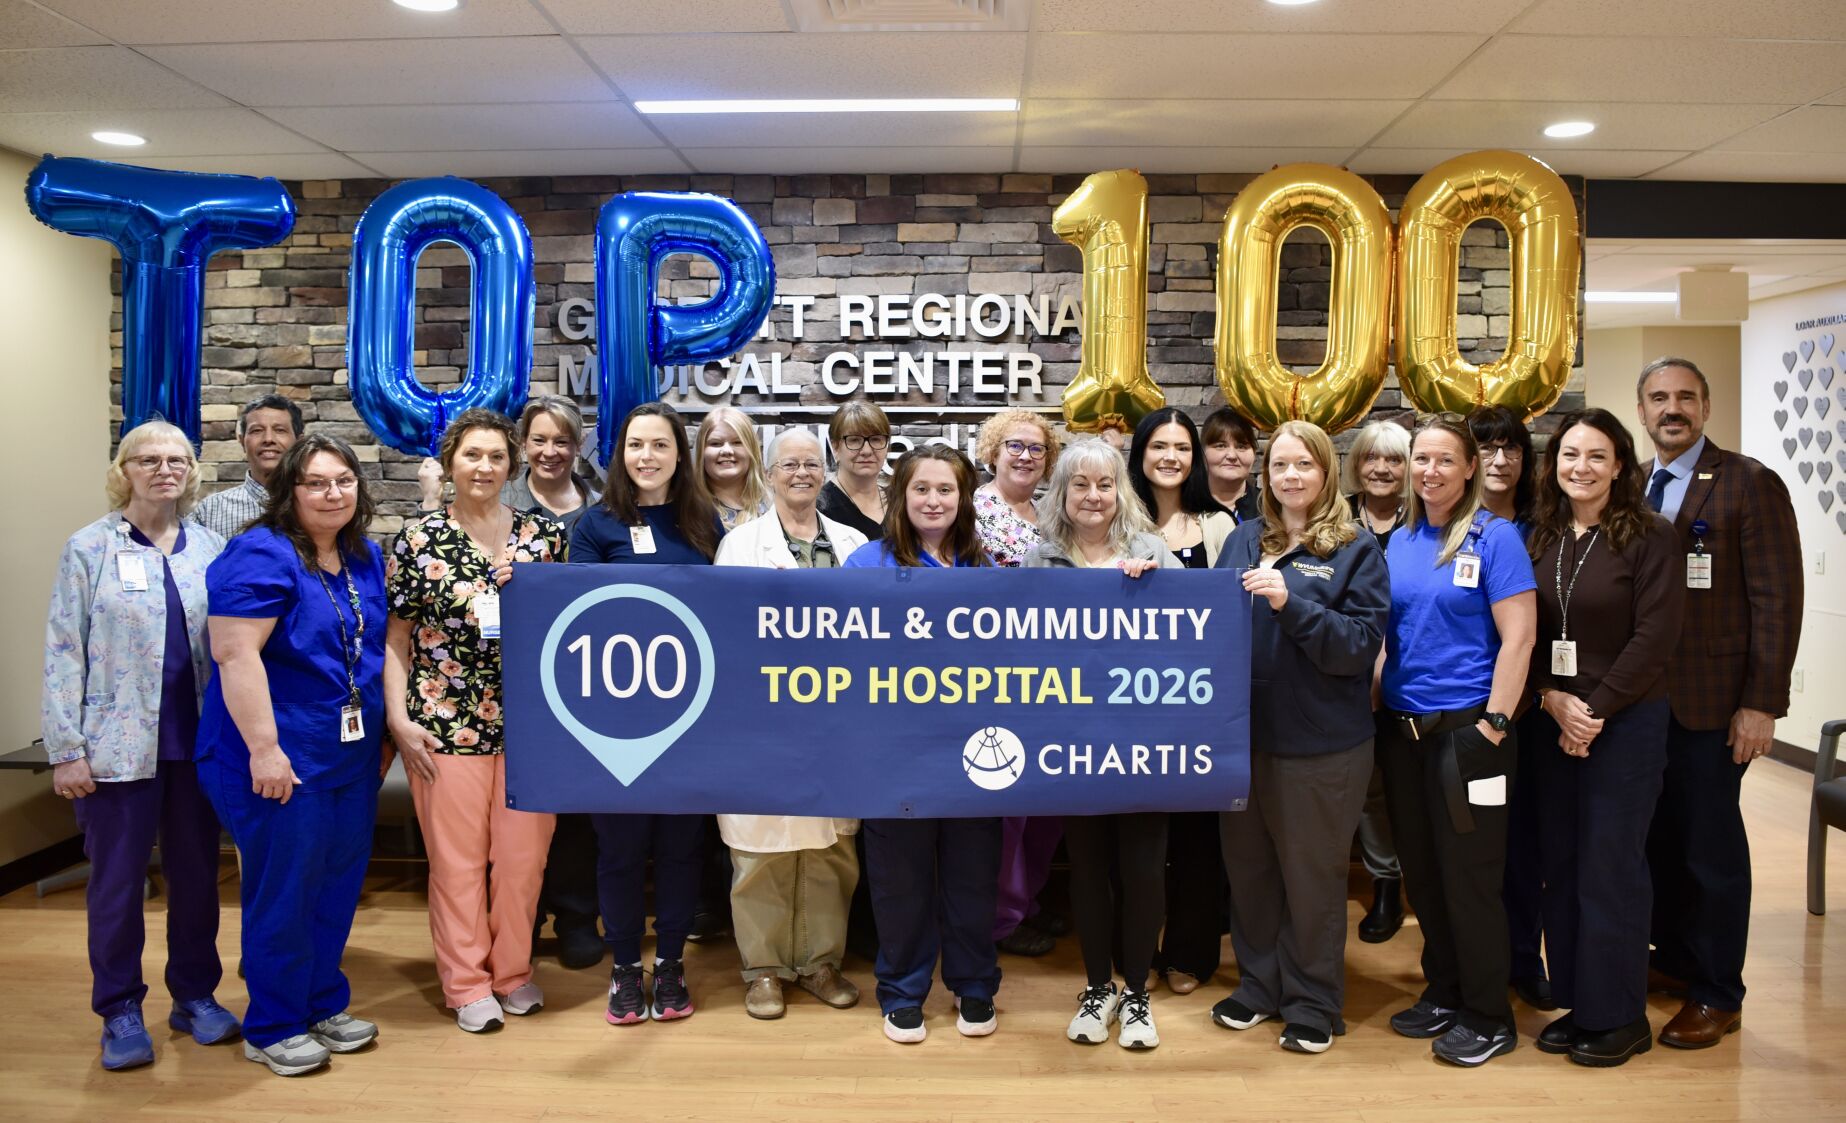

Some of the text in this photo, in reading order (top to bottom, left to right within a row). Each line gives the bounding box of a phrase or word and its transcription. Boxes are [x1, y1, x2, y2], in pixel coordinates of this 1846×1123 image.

[25, 150, 1580, 470] TOP 100
[839, 294, 1083, 338] REGIONA
[559, 351, 1043, 397] MICAL CENTER
[757, 606, 1212, 640] RURAL & COMMUNITY
[567, 634, 687, 699] 100
[760, 666, 1214, 705] TOP HOSPITAL 2026
[1038, 744, 1213, 775] CHARTIS
